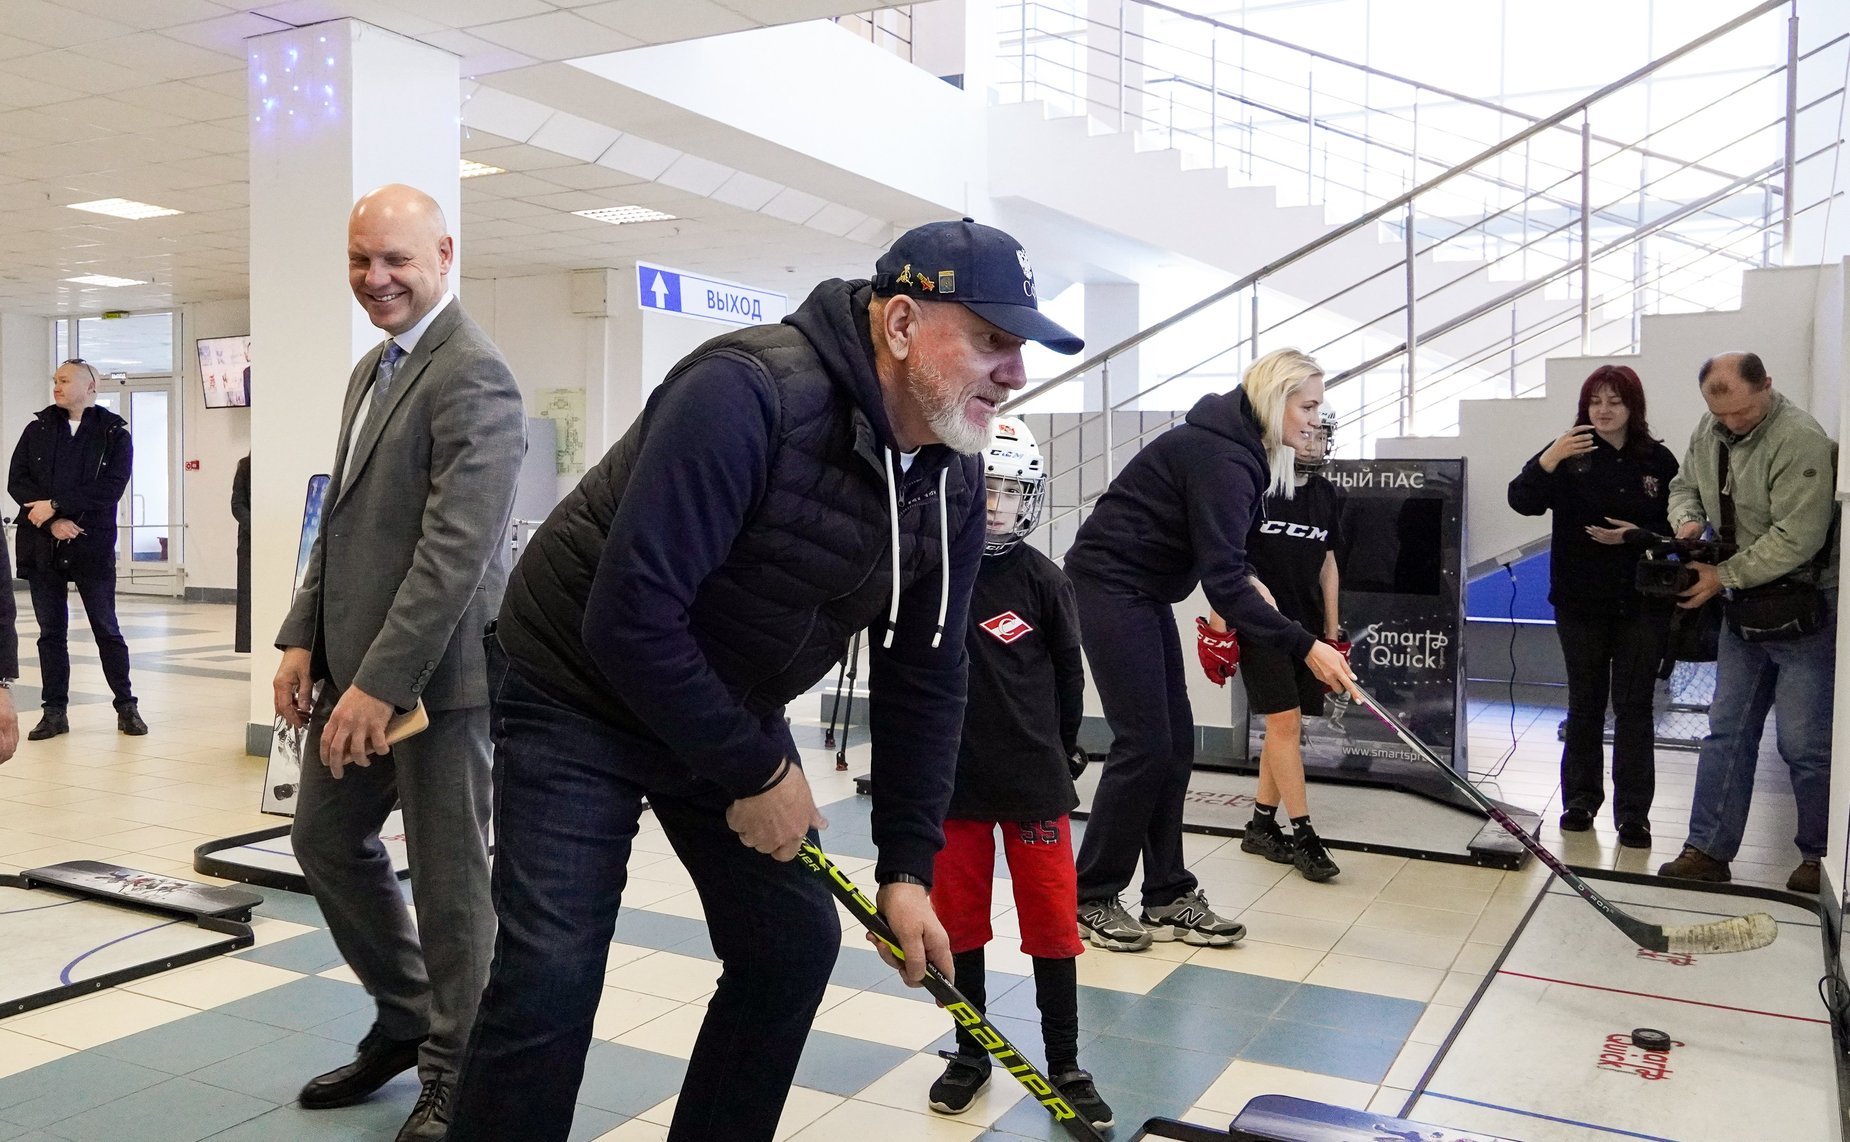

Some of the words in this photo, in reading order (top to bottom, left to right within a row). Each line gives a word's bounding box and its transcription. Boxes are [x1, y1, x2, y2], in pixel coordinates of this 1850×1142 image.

[707, 289, 762, 322] ВЫХОД
[1380, 472, 1424, 489] ПАС
[1259, 520, 1329, 542] CCM
[1370, 644, 1437, 669] Quick
[1342, 745, 1430, 763] www.smartspr
[800, 836, 878, 916] XUS
